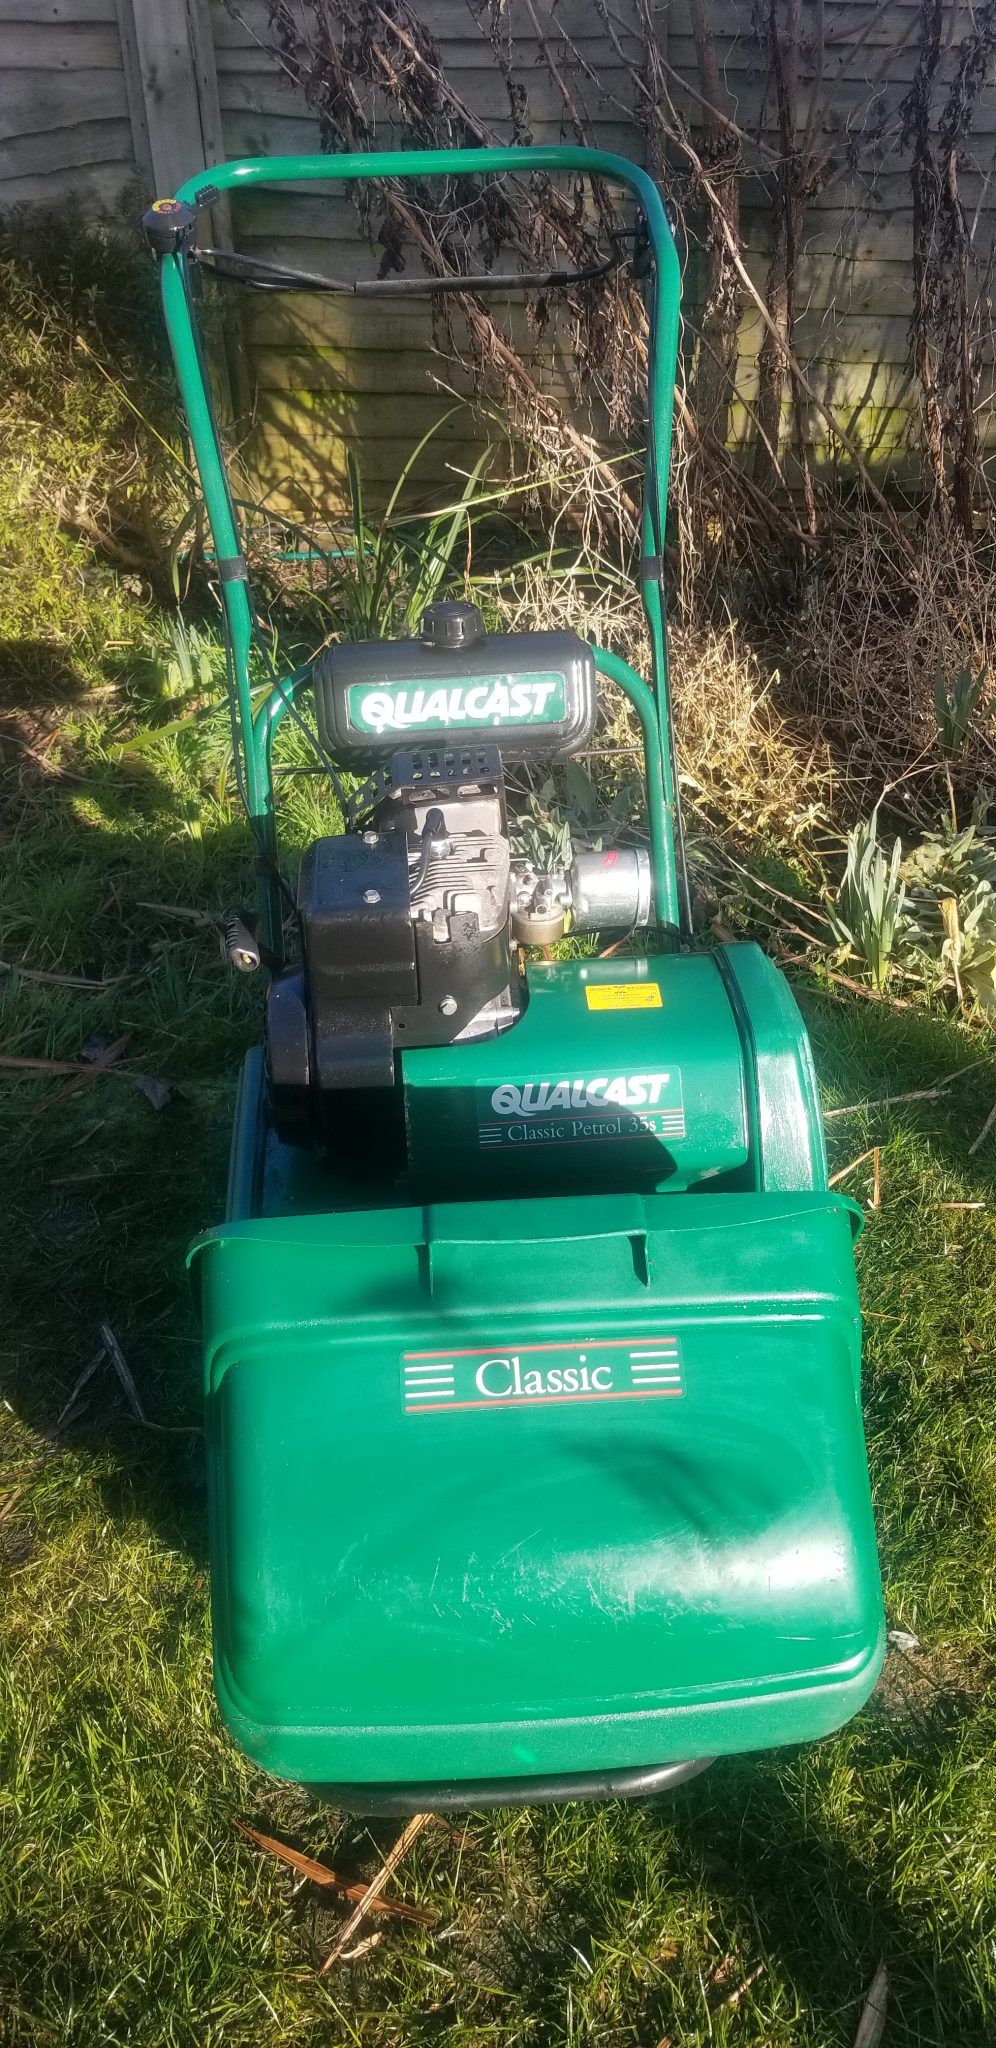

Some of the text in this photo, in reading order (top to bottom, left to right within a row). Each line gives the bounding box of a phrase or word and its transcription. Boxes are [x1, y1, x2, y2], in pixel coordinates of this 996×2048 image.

[361, 682, 556, 728] QUALCAST
[491, 1074, 670, 1117] QUALCAST
[508, 1115, 657, 1142] Classic Petrol 35s
[475, 1354, 613, 1397] Classic
